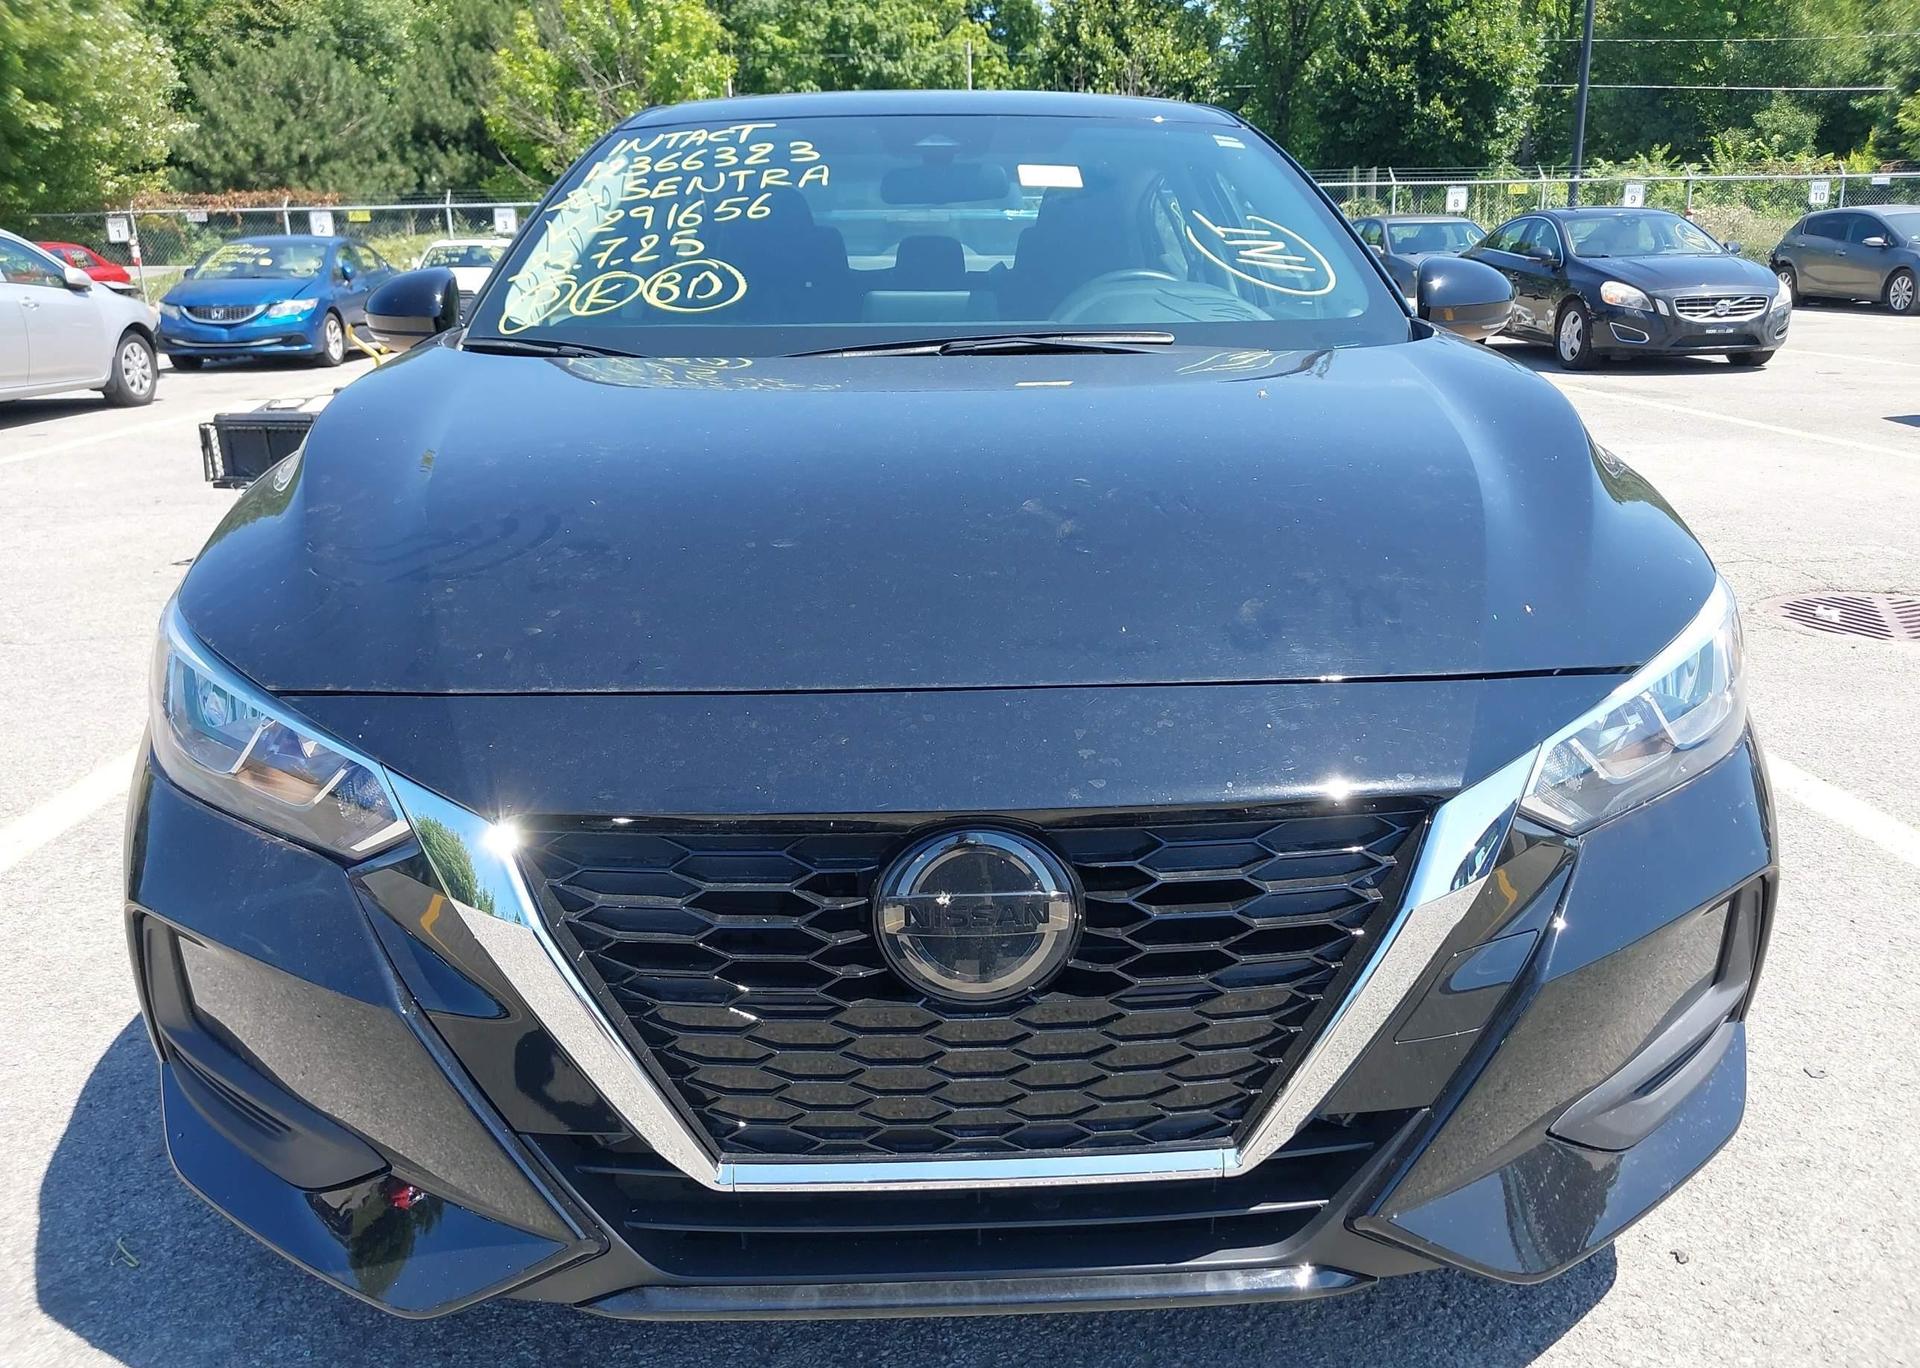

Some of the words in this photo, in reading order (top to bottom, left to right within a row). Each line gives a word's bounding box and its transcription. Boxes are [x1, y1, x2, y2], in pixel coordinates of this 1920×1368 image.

[608, 123, 777, 157] INTACT
[619, 164, 830, 202] SENTRA
[1813, 192, 1826, 201] 10
[591, 193, 772, 233] 291656
[1453, 199, 1459, 208] 8
[1630, 195, 1637, 204] 9
[904, 901, 1050, 929] NISSAN
